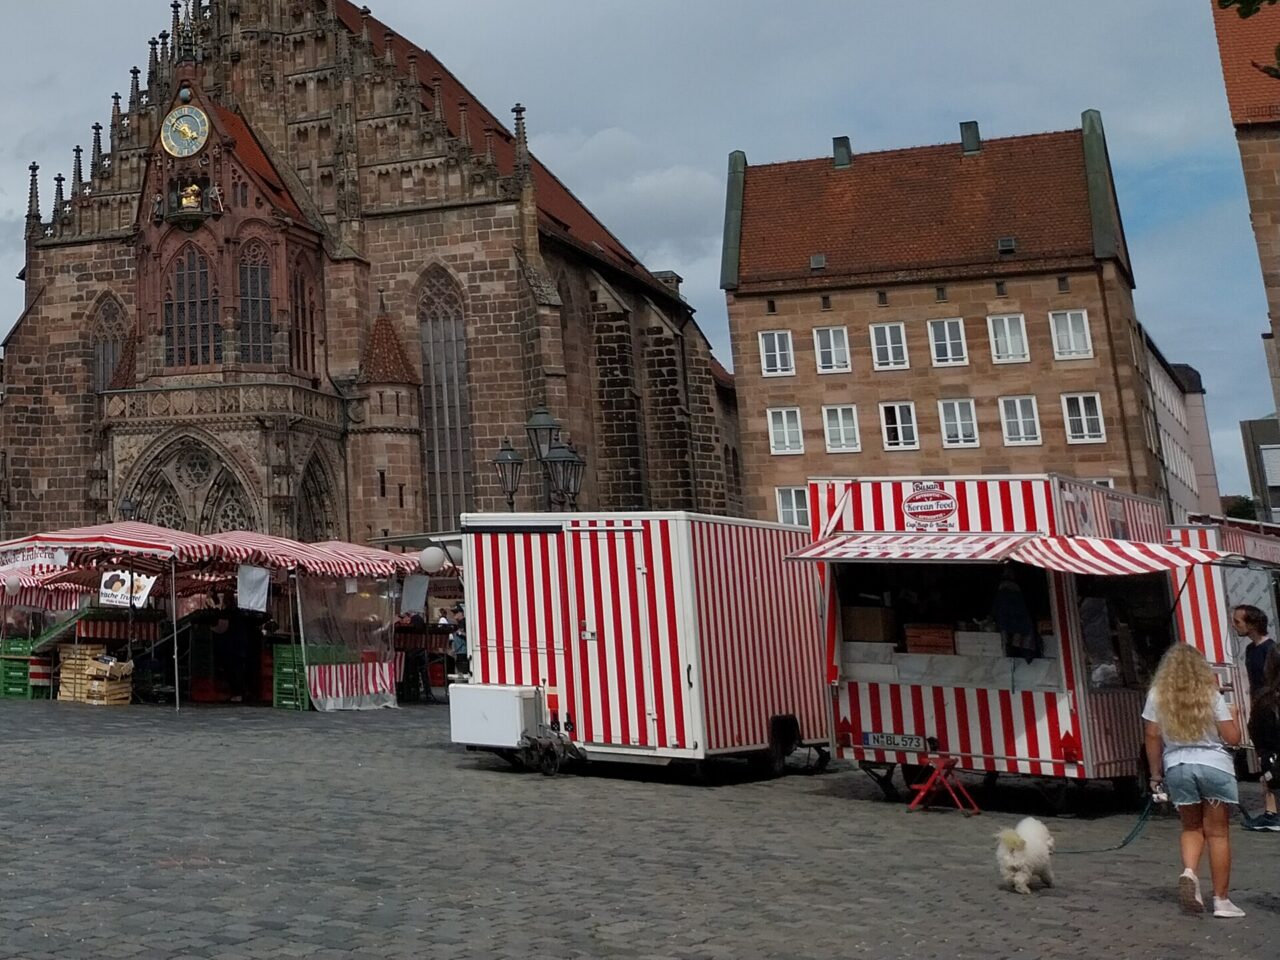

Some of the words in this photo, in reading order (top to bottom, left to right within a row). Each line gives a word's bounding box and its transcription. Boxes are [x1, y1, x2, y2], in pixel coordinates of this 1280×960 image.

[906, 503, 934, 512] Korean
[935, 501, 954, 509] Food
[872, 734, 880, 745] N
[886, 735, 900, 746] BL
[901, 736, 921, 747] 573
